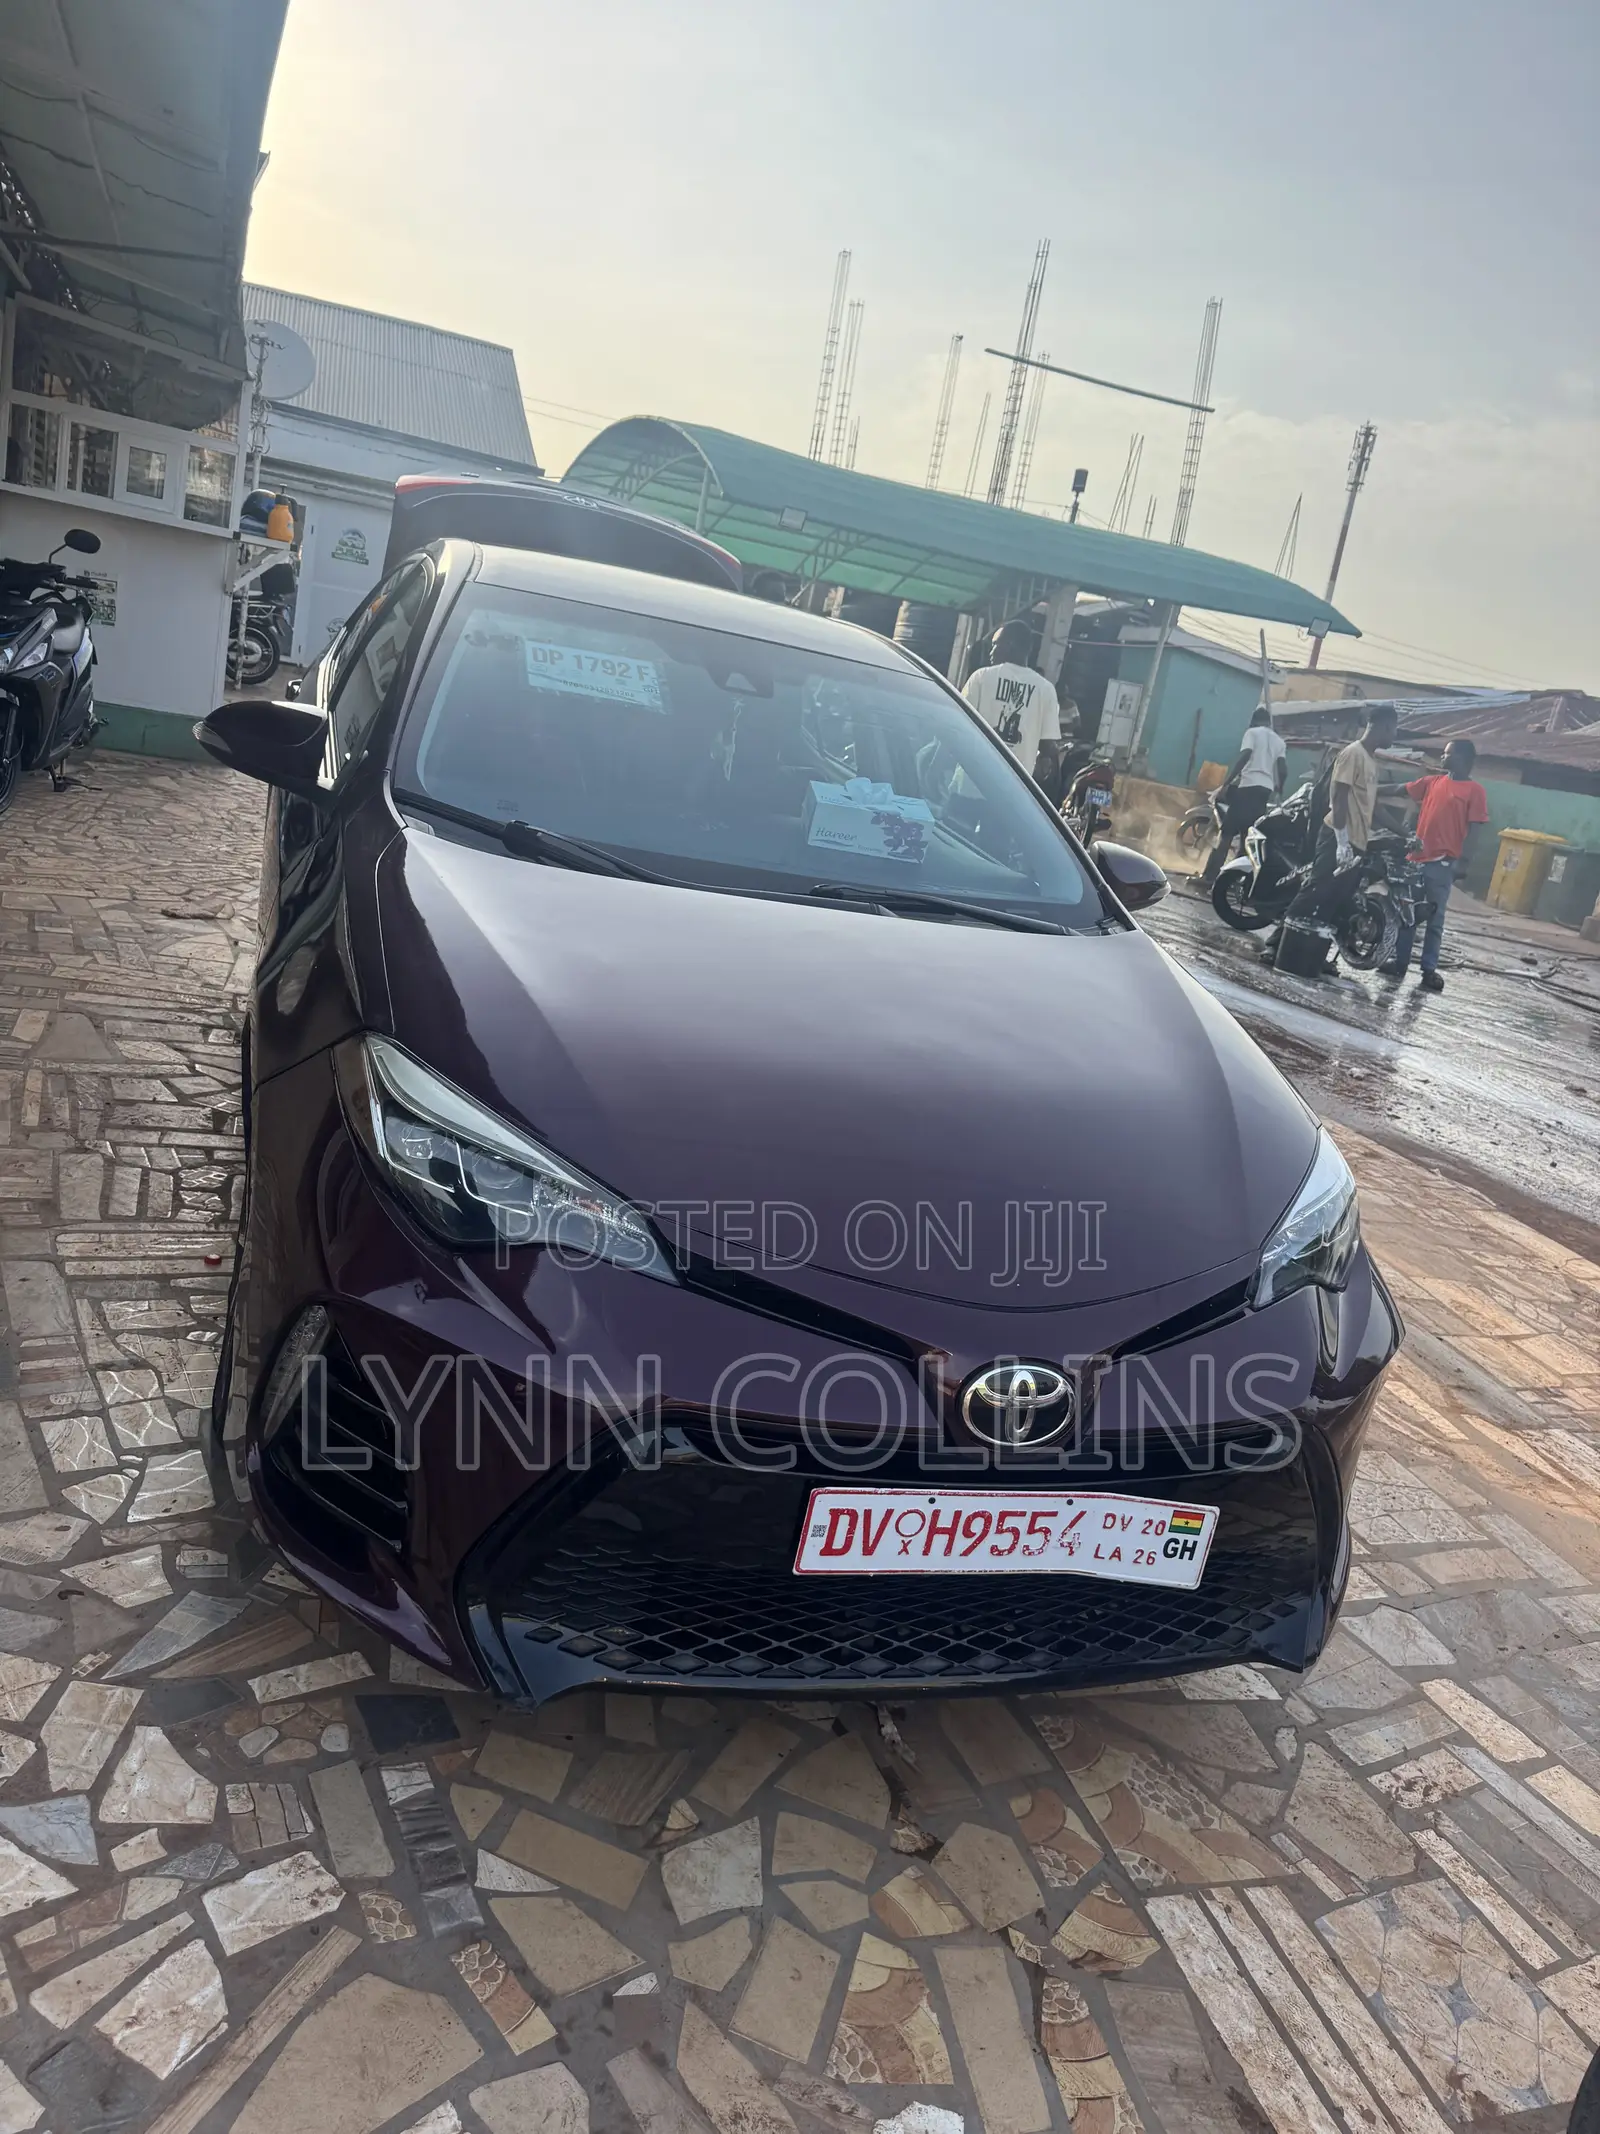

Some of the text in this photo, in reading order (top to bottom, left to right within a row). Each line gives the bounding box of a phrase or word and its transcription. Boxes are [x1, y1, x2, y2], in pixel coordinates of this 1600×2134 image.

[531, 646, 651, 682] DP 1792 F
[1101, 1511, 1168, 1536] DV 20
[1092, 1543, 1158, 1566] LA 26
[1162, 1537, 1199, 1561] GH
